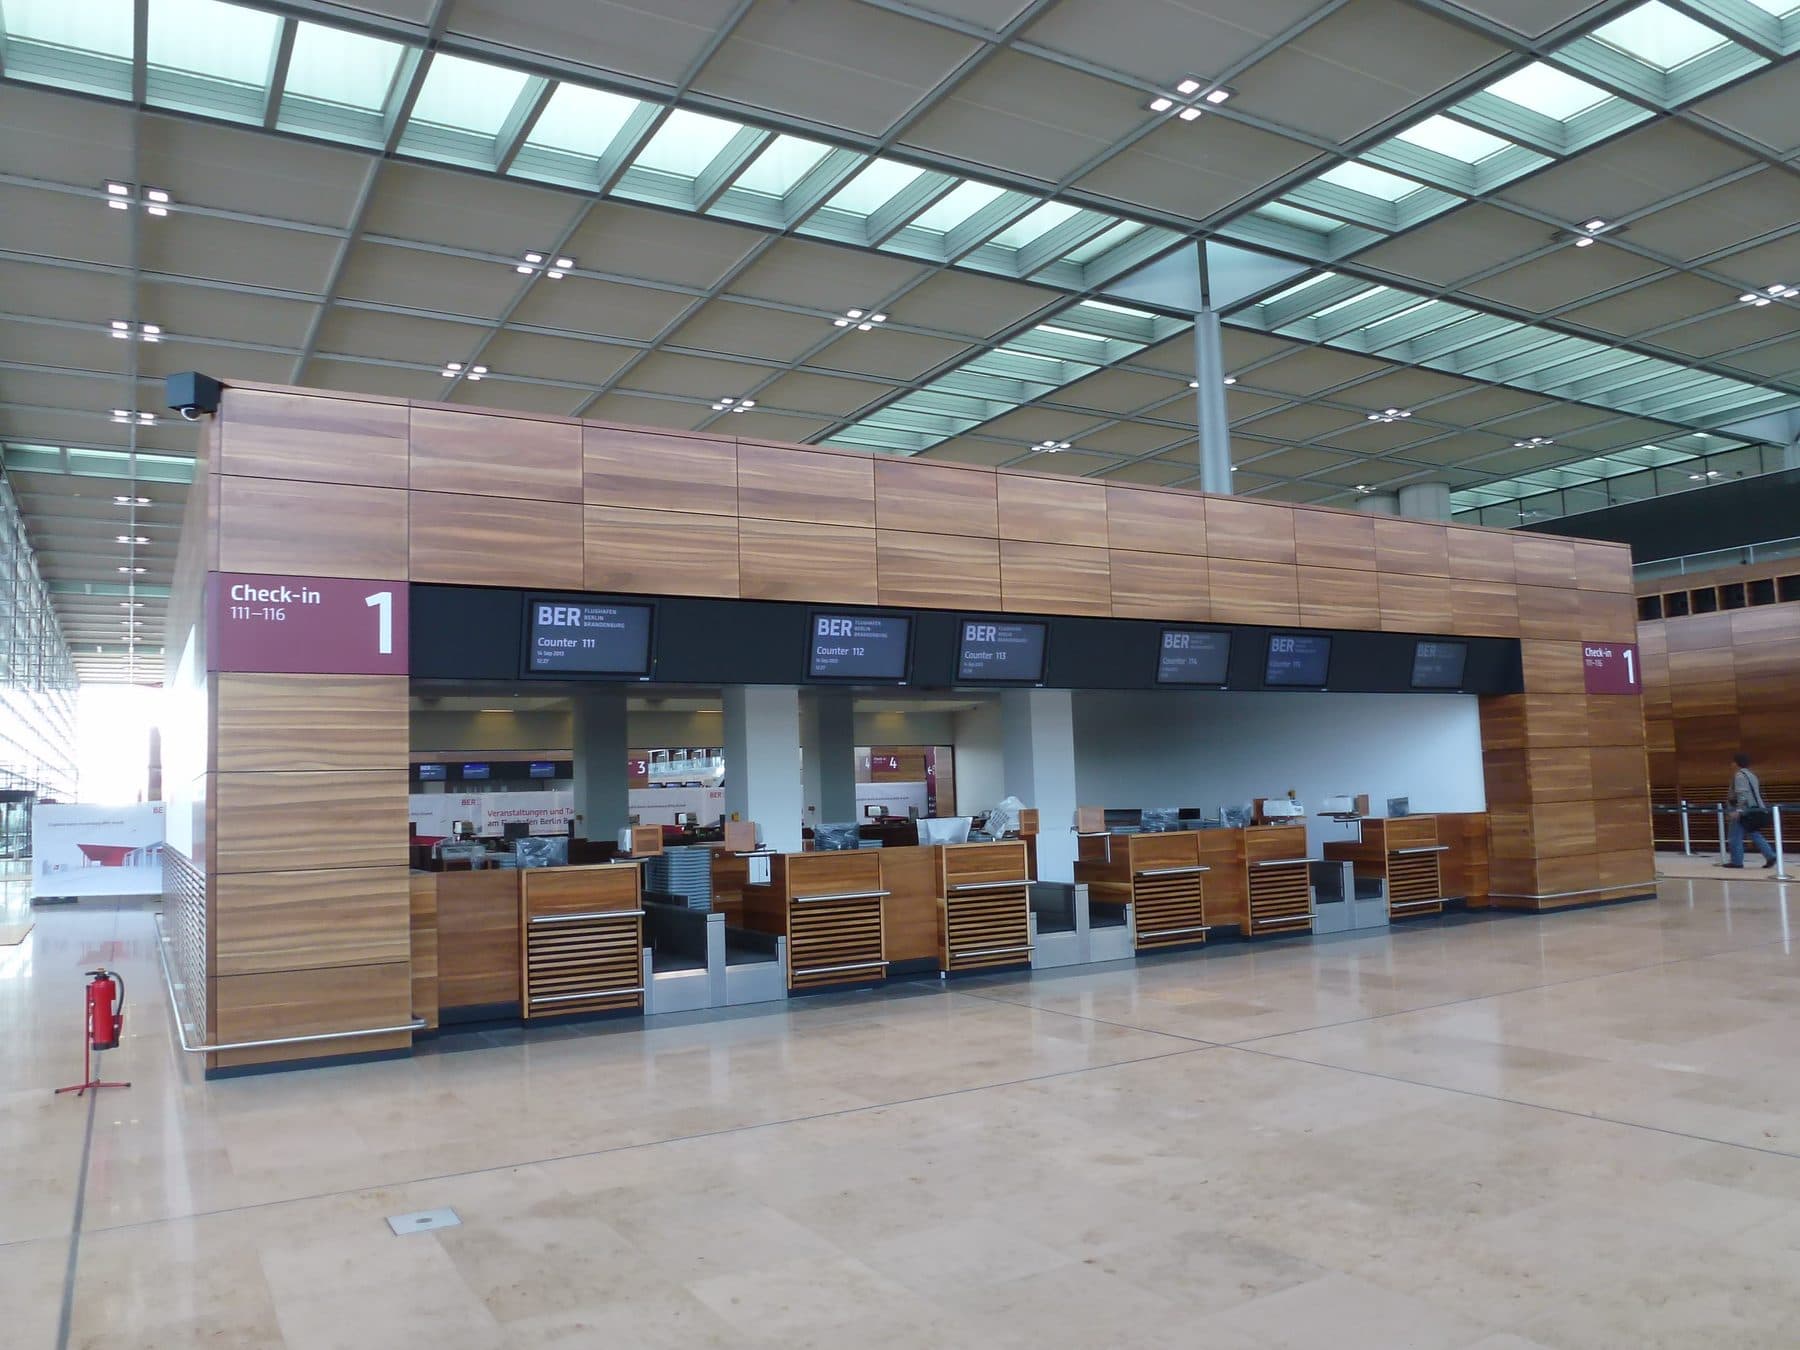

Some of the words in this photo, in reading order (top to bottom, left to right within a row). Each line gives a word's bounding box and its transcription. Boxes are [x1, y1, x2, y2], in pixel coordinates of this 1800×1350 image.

[231, 584, 320, 604] Check-in
[364, 591, 392, 654] 1
[538, 606, 580, 626] BER
[818, 619, 853, 637] BER
[966, 625, 996, 642] BER
[538, 637, 578, 648] Counter
[582, 639, 595, 648] 111
[1164, 633, 1190, 649] BER
[1271, 638, 1295, 653] BER
[816, 646, 849, 656] Counter
[852, 647, 865, 656] 112
[964, 651, 993, 660] Counter
[996, 652, 1007, 660] 113
[1585, 647, 1613, 658] Check-in
[1623, 649, 1635, 684] 1
[637, 760, 646, 774] 3
[889, 757, 898, 769] 4
[709, 791, 722, 799] BER
[488, 808, 548, 818] Veranstaltungen
[550, 807, 564, 815] und
[488, 820, 500, 828] am
[540, 817, 563, 825] Berlin
